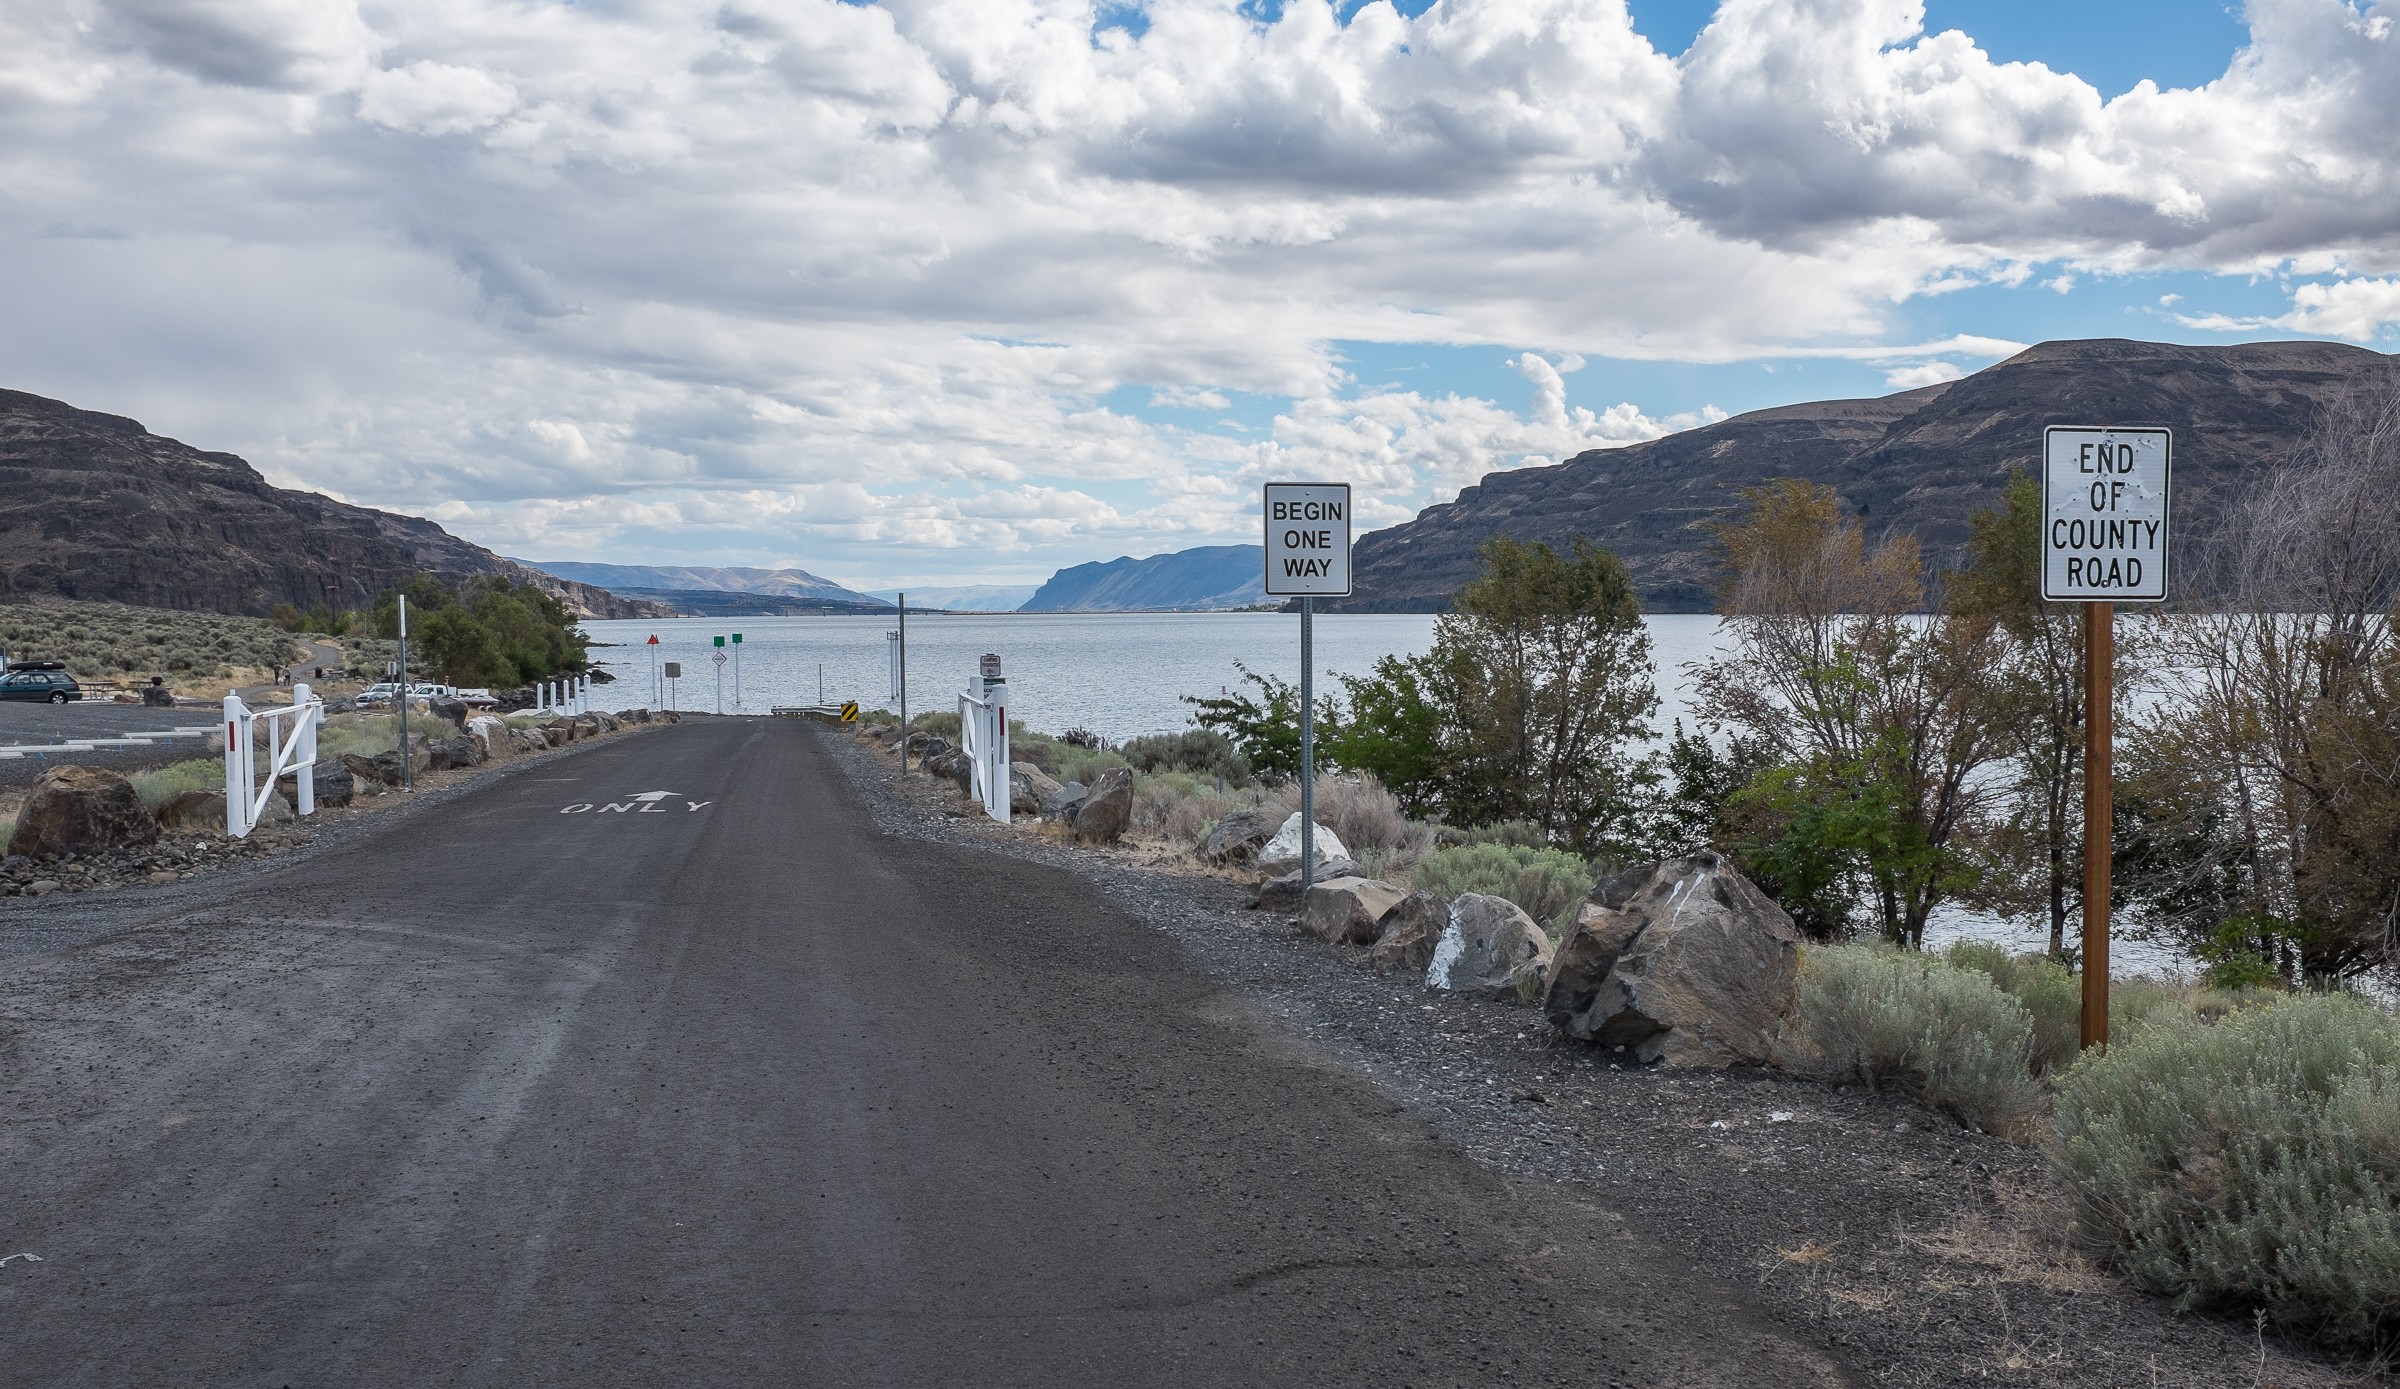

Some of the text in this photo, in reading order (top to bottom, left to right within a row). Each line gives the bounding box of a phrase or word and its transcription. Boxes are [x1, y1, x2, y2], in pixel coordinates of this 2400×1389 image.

[2080, 443, 2134, 474] END
[2090, 481, 2126, 512] OF
[1273, 502, 1342, 520] BEGIN
[1284, 530, 1332, 549] ONE
[2052, 518, 2161, 550] COUNTY
[1283, 558, 1333, 577] WAY
[2067, 557, 2143, 588] ROAD
[560, 801, 713, 814] ONLY
